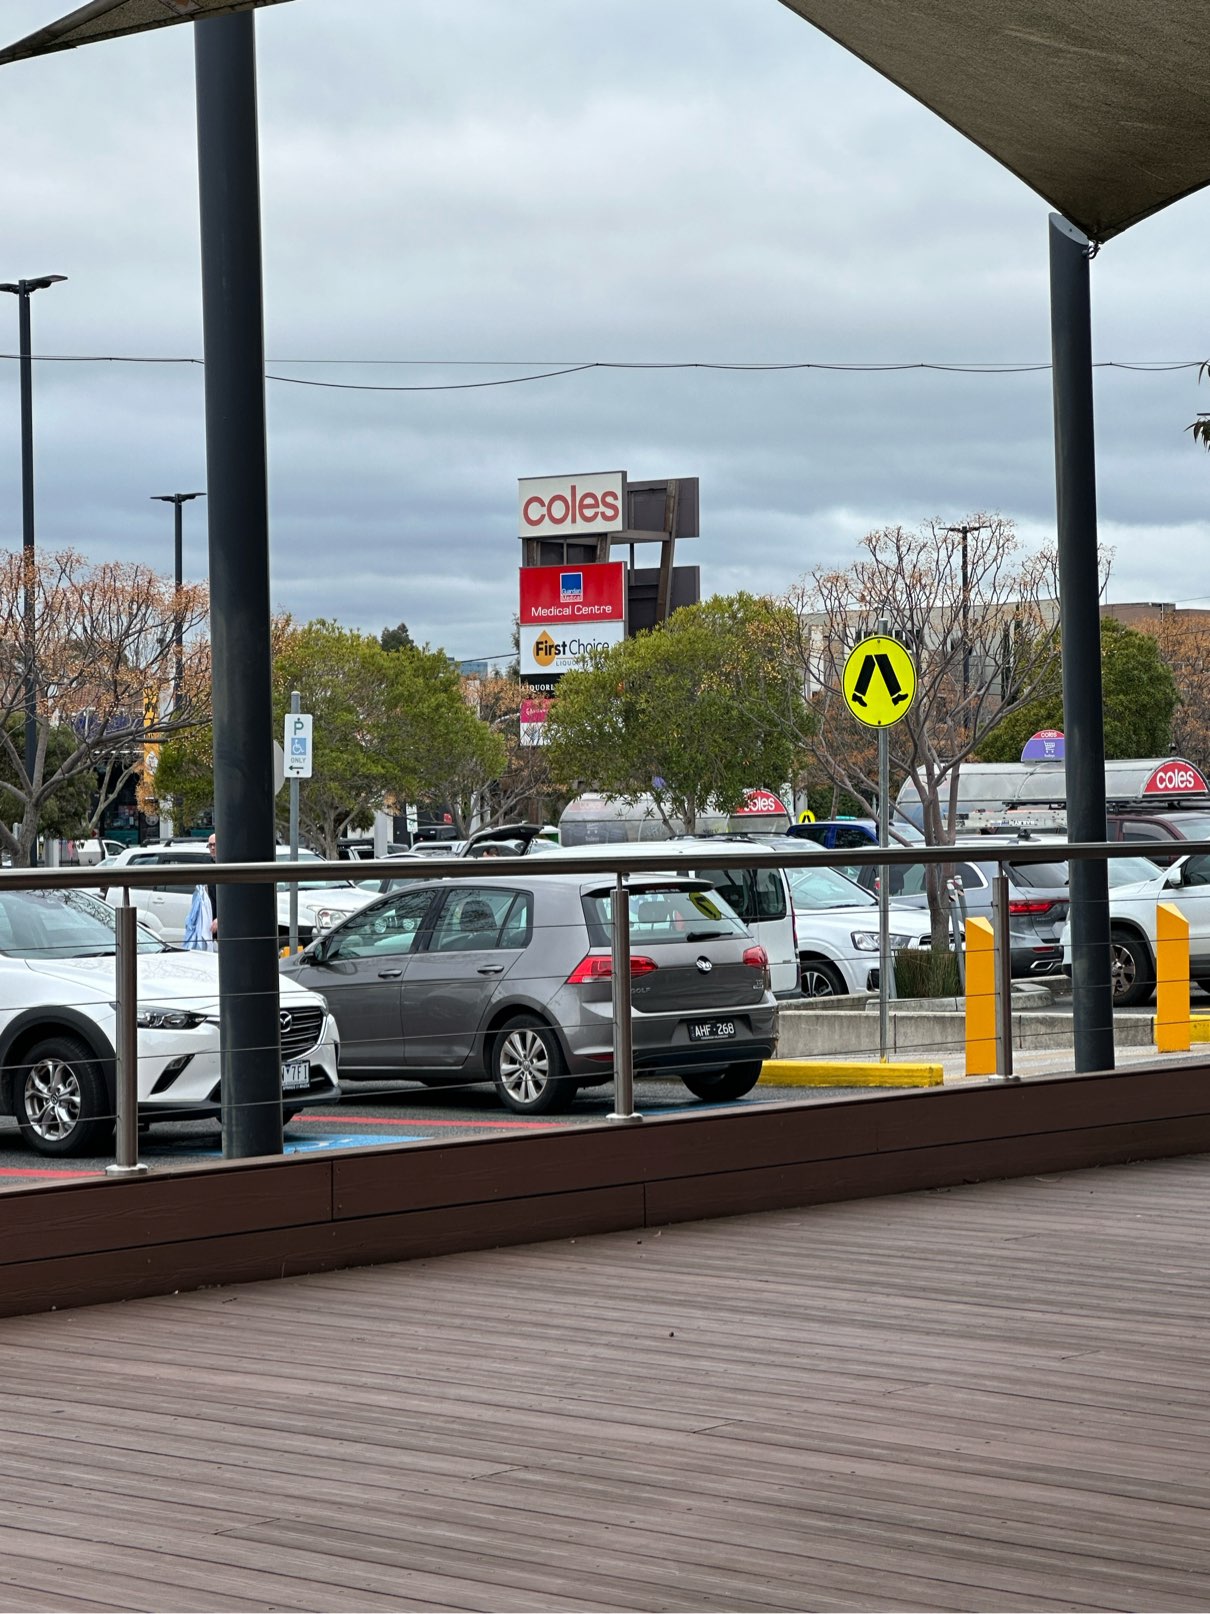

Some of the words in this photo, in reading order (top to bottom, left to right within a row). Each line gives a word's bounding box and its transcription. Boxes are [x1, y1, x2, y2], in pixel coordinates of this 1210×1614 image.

[523, 485, 619, 526] coles
[531, 605, 572, 617] Medical
[574, 604, 613, 616] Centre
[293, 720, 304, 736] P
[1156, 768, 1195, 790] coles
